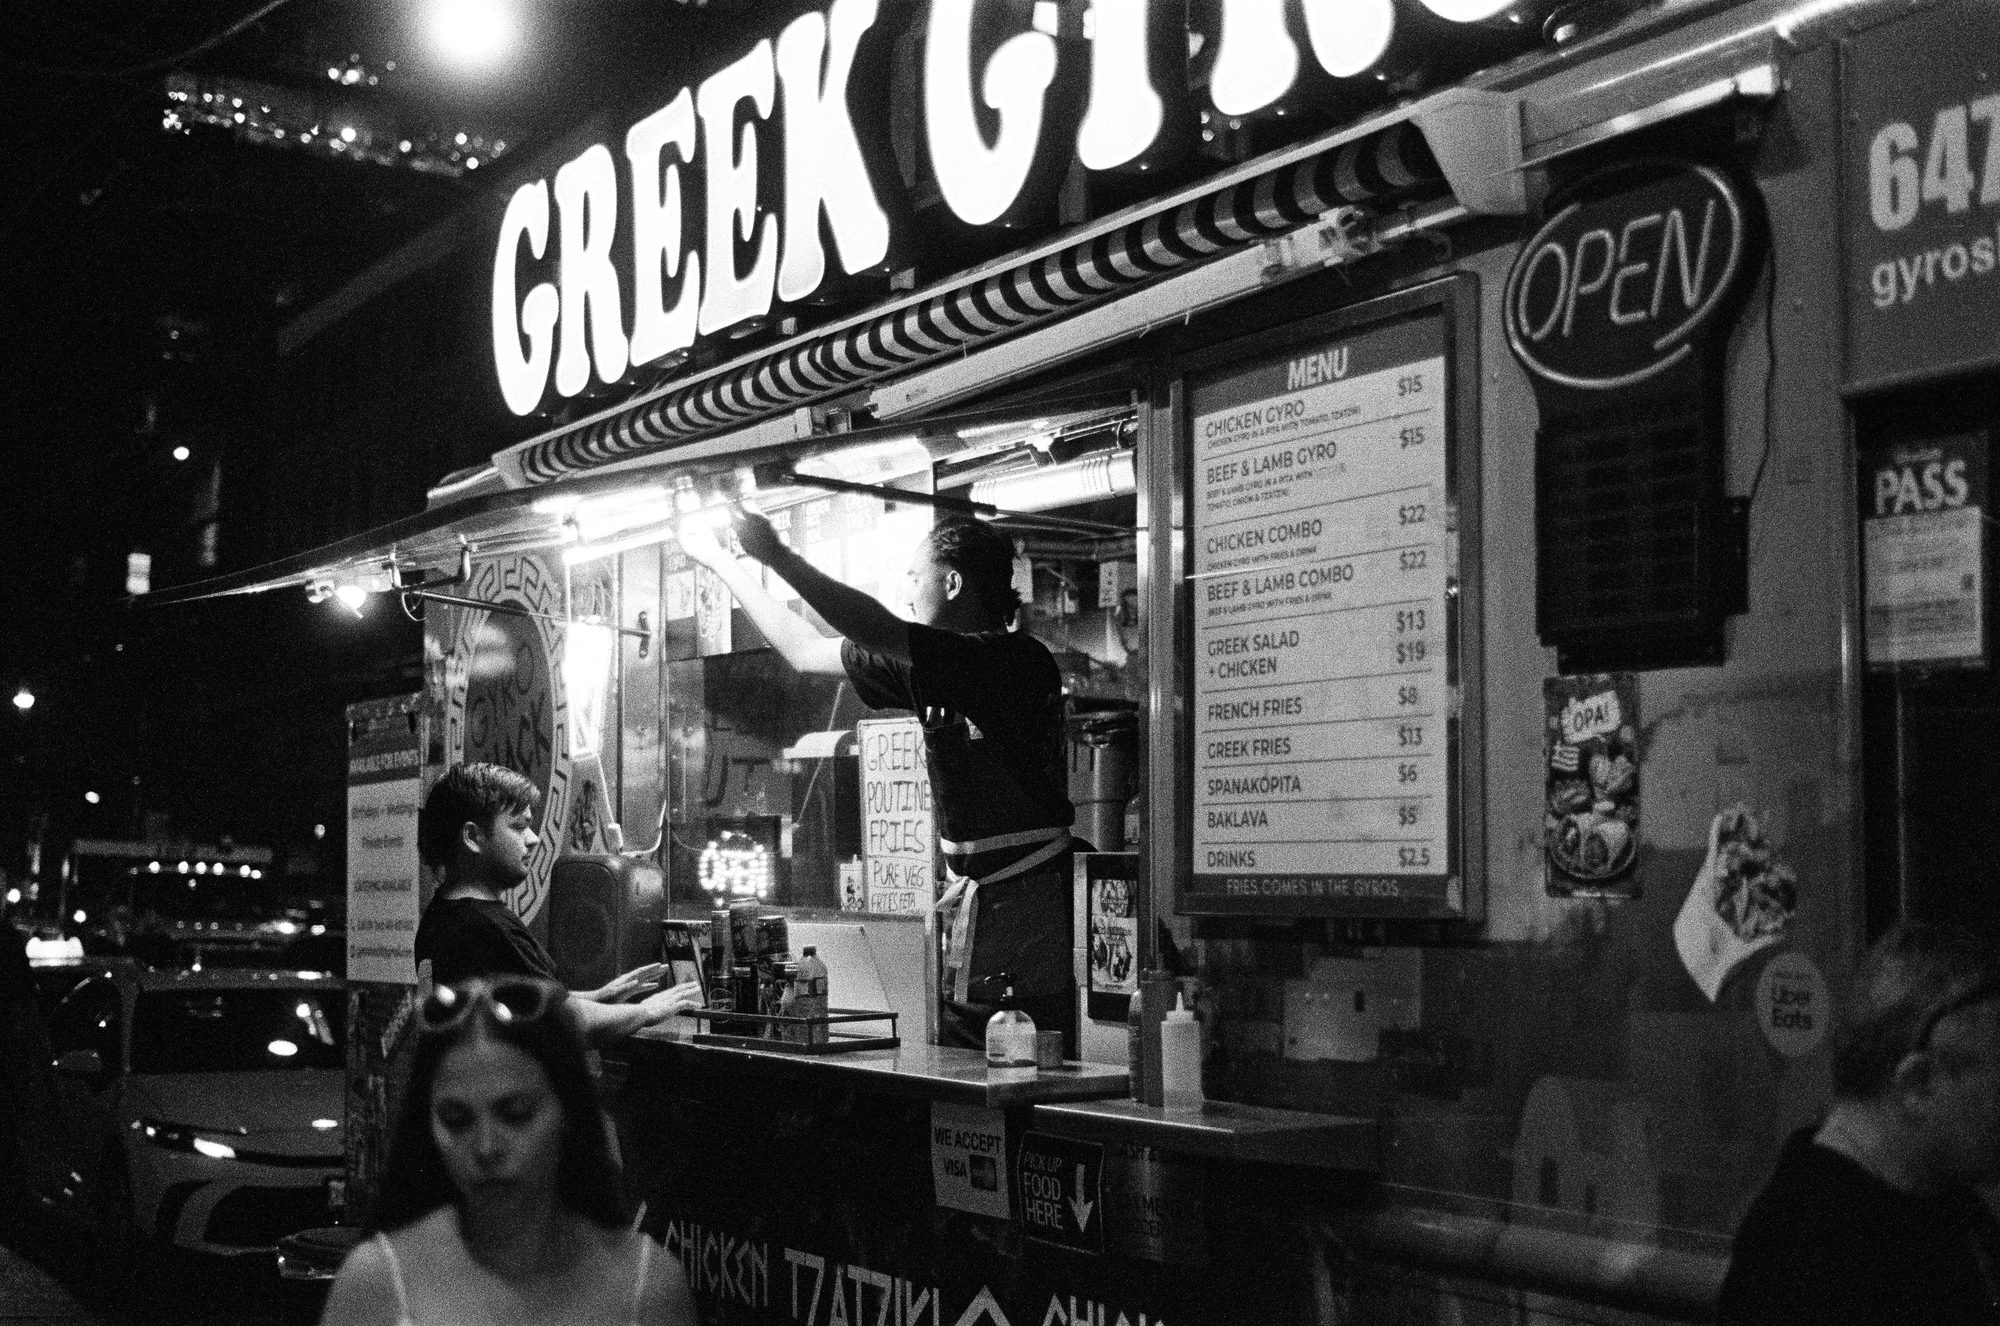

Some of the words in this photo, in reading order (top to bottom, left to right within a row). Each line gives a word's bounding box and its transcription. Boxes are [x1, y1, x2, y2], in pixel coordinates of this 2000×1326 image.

[1869, 94, 2000, 231] 647
[492, 0, 889, 416] GREEK
[1518, 198, 1716, 341] OPEN
[1872, 222, 2000, 309] gyros
[1287, 348, 1348, 390] MENU
[1205, 409, 1263, 438] CHICKEN
[1266, 400, 1306, 424] GYRO
[1397, 374, 1424, 397] $15
[1206, 462, 1238, 484] BEEF
[1240, 460, 1250, 477] &
[1253, 451, 1293, 474] LAMB
[1297, 441, 1337, 465] GYRO
[1399, 426, 1425, 449] $15
[1875, 459, 1969, 514] PASS
[1207, 529, 1264, 554] CHICKEN
[1268, 519, 1322, 544] COMBO
[1399, 504, 1425, 526] $22
[1208, 582, 1239, 602] BEEF
[1242, 579, 1251, 596] &
[1255, 573, 1295, 594] LAMB
[1299, 564, 1354, 588] COMBO
[1400, 551, 1426, 572] $22
[1208, 633, 1249, 656] GREEK
[1252, 629, 1299, 652] SALAD
[1397, 609, 1426, 633] $13
[1218, 656, 1277, 680] CHICKEN
[1397, 641, 1425, 665] $19
[1208, 699, 1260, 721] FRENCH
[1263, 697, 1301, 716] FRIES
[1573, 706, 1610, 731] OPA!
[866, 731, 928, 771] GREEK
[1208, 740, 1249, 759] GREEK
[1253, 737, 1291, 756] FRIES
[1398, 726, 1423, 747] $13
[867, 780, 933, 814] POUTINE
[1208, 774, 1301, 796] SPANAKOPITA
[1207, 809, 1268, 828] BAKLAVA
[870, 819, 926, 854] FRIES
[873, 860, 900, 888] PURE
[904, 865, 926, 888] VEG
[1207, 850, 1255, 868] DRINKS
[1226, 879, 1259, 896] FRIES
[1262, 879, 1307, 896] COMES
[1310, 879, 1324, 895] IN
[1327, 879, 1350, 895] THE
[1353, 879, 1399, 897] GYROS
[1771, 1007, 1813, 1030] Eats
[934, 1127, 953, 1145] WE
[954, 1130, 1003, 1151] ACCEPT
[944, 1158, 967, 1177] VISA
[1023, 1151, 1047, 1171] PICK
[1048, 1156, 1063, 1173] UP
[1023, 1171, 1063, 1200] FOOD
[1025, 1197, 1064, 1231] HERE
[663, 1220, 768, 1309] CHICKEN
